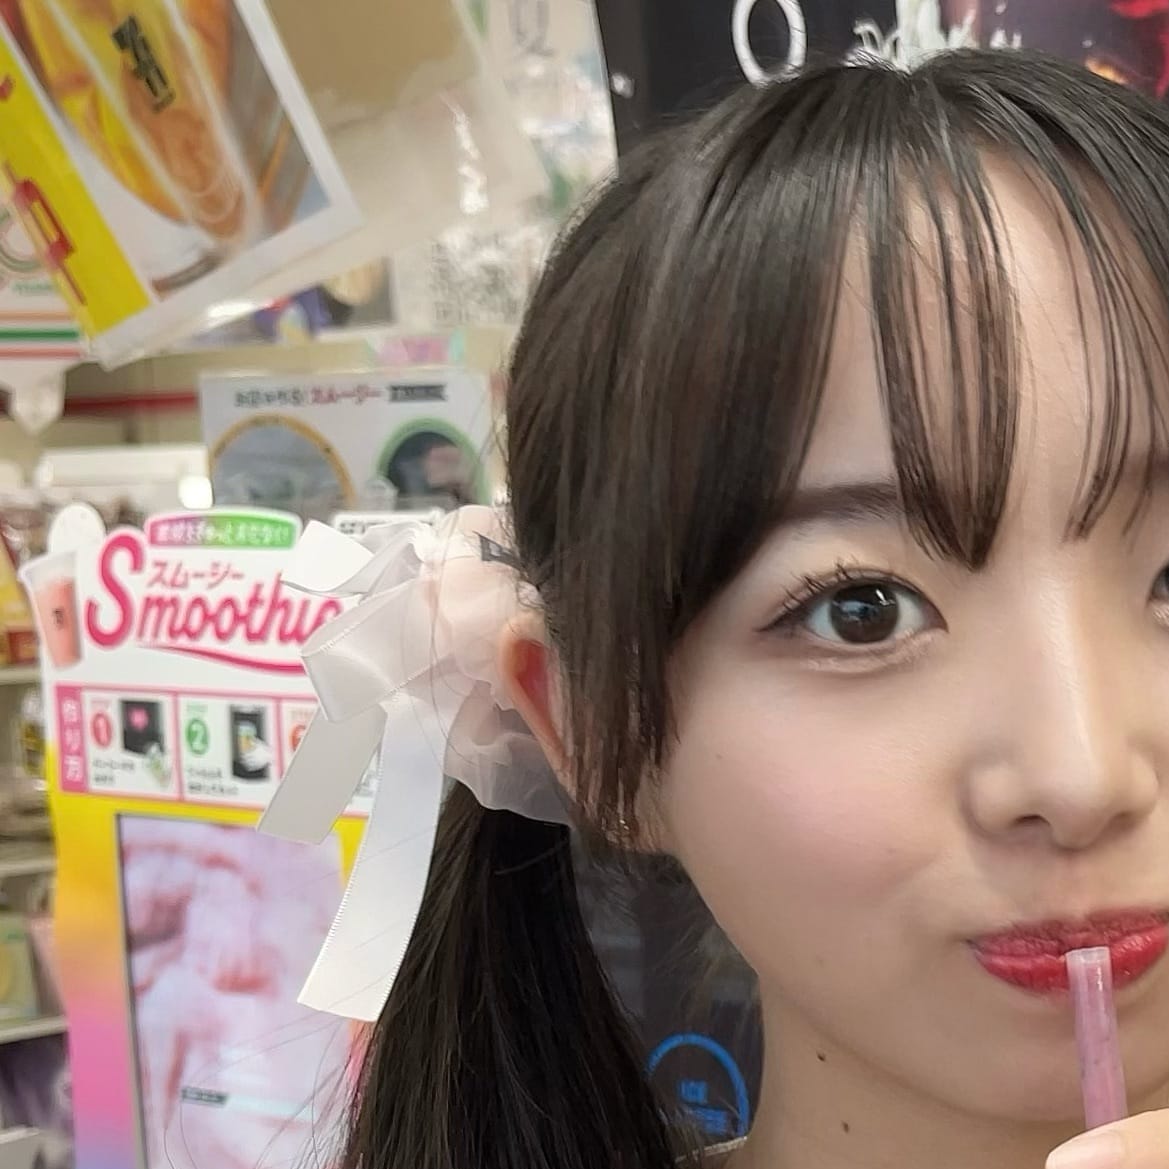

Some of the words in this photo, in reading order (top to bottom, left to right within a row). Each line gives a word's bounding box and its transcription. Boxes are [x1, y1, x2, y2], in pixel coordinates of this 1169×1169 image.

[146, 561, 245, 590] スムージー
